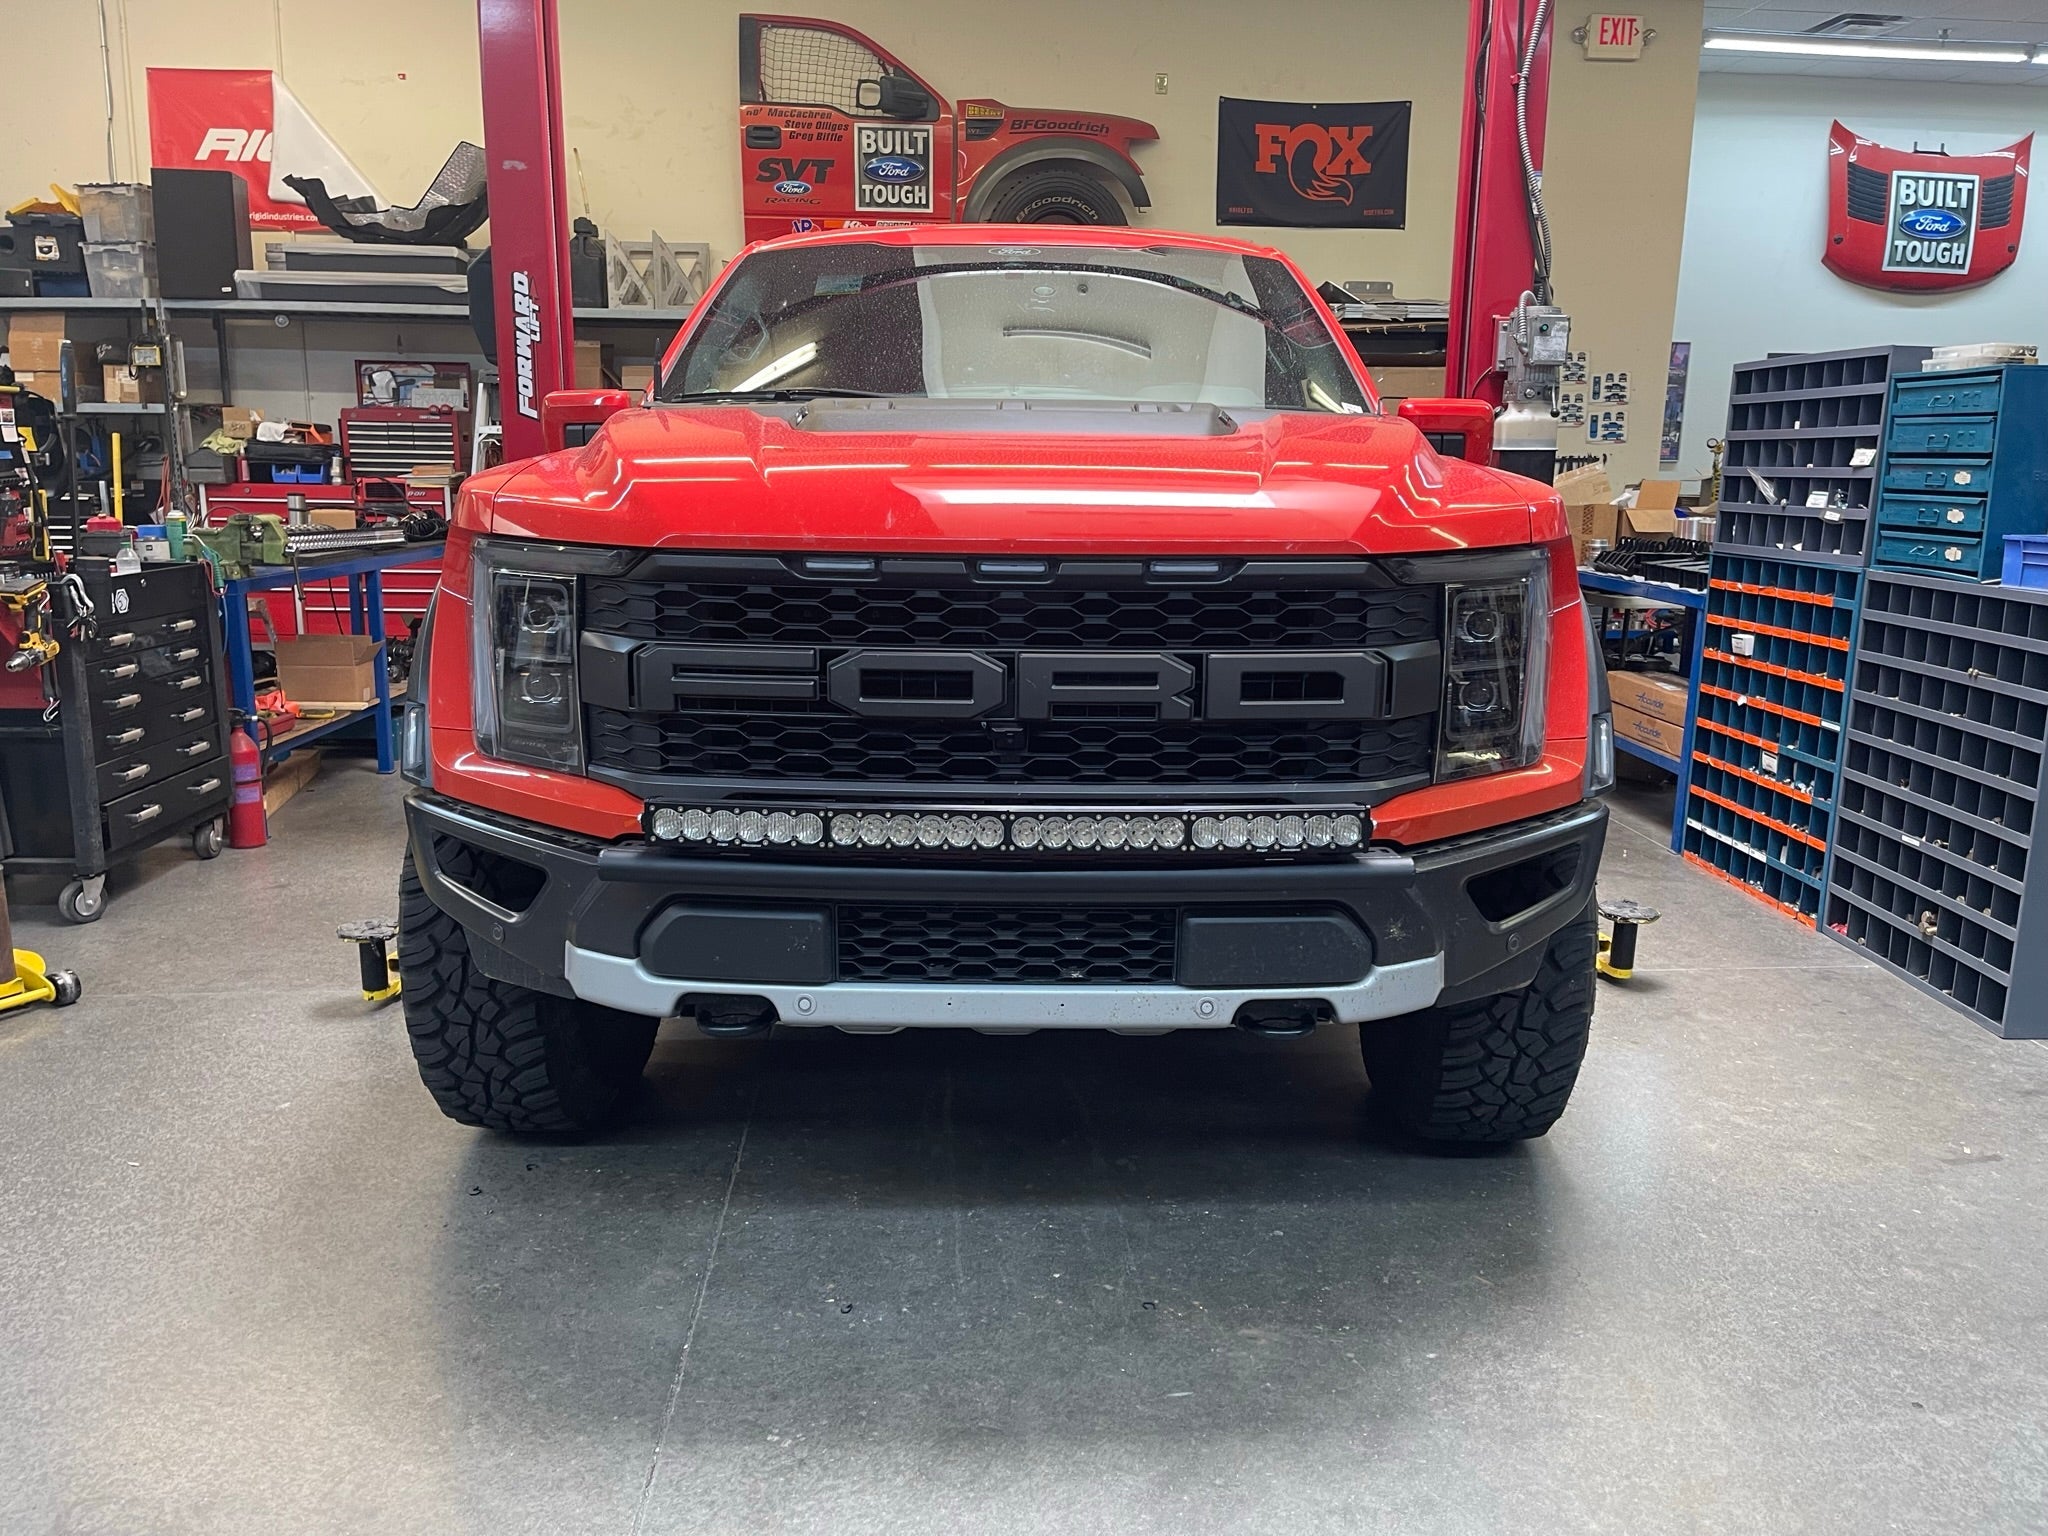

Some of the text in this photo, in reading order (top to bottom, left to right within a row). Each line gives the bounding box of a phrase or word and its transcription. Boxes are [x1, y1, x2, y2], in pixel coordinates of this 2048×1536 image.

[1599, 17, 1637, 46] EXIT
[767, 108, 832, 120] MacCachren
[784, 119, 850, 132] Steve Olliges
[1010, 119, 1110, 134] BFGoodrich
[789, 130, 844, 143] Greg Biffle
[861, 130, 928, 155] BUILT
[756, 157, 835, 183] SVT
[878, 162, 911, 177] Ford
[1255, 123, 1374, 206] FOX
[764, 197, 821, 205] RACING
[780, 183, 805, 195] Ford
[861, 184, 927, 205] TOUGH
[1900, 178, 1973, 208] BUILT
[1015, 196, 1099, 223] BFGoodrich
[1915, 215, 1950, 233] Ford
[1893, 240, 1966, 265] TOUGH
[528, 298, 541, 343] LIFT
[512, 271, 539, 420] FORWARD
[633, 646, 1388, 720] FORD
